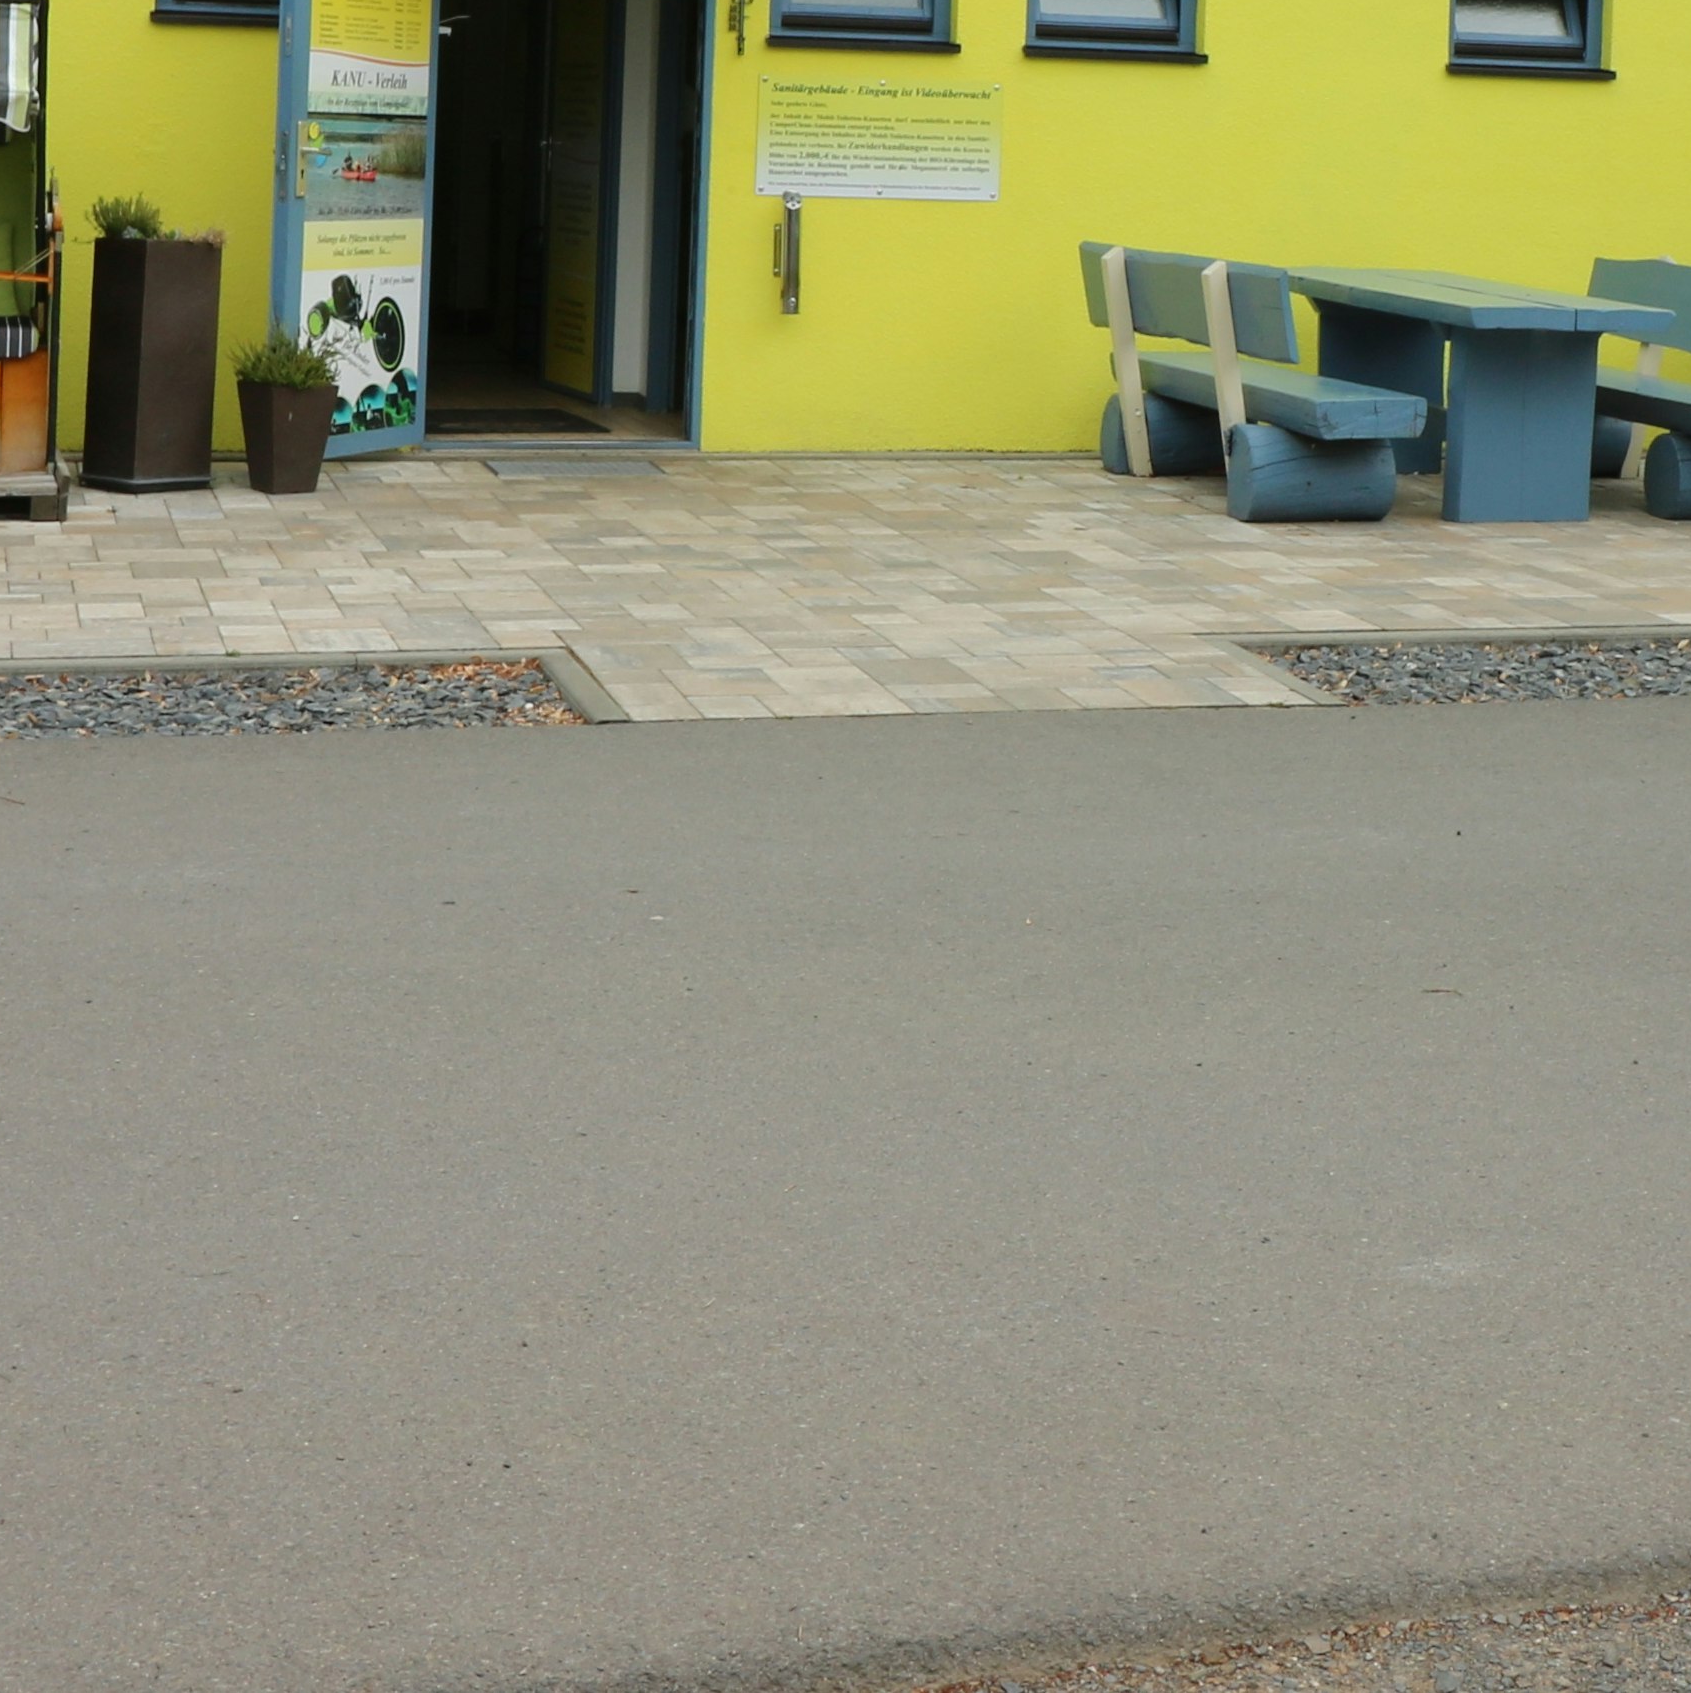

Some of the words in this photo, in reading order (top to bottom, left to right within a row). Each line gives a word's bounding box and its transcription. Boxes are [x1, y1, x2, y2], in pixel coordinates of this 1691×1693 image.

[330, 70, 366, 88] KANU
[375, 72, 408, 89] Verleih
[771, 82, 849, 96] Sanitärgebäude
[857, 86, 898, 98] Eingang
[900, 87, 914, 97] ist
[915, 88, 992, 100] Videoüberwacht
